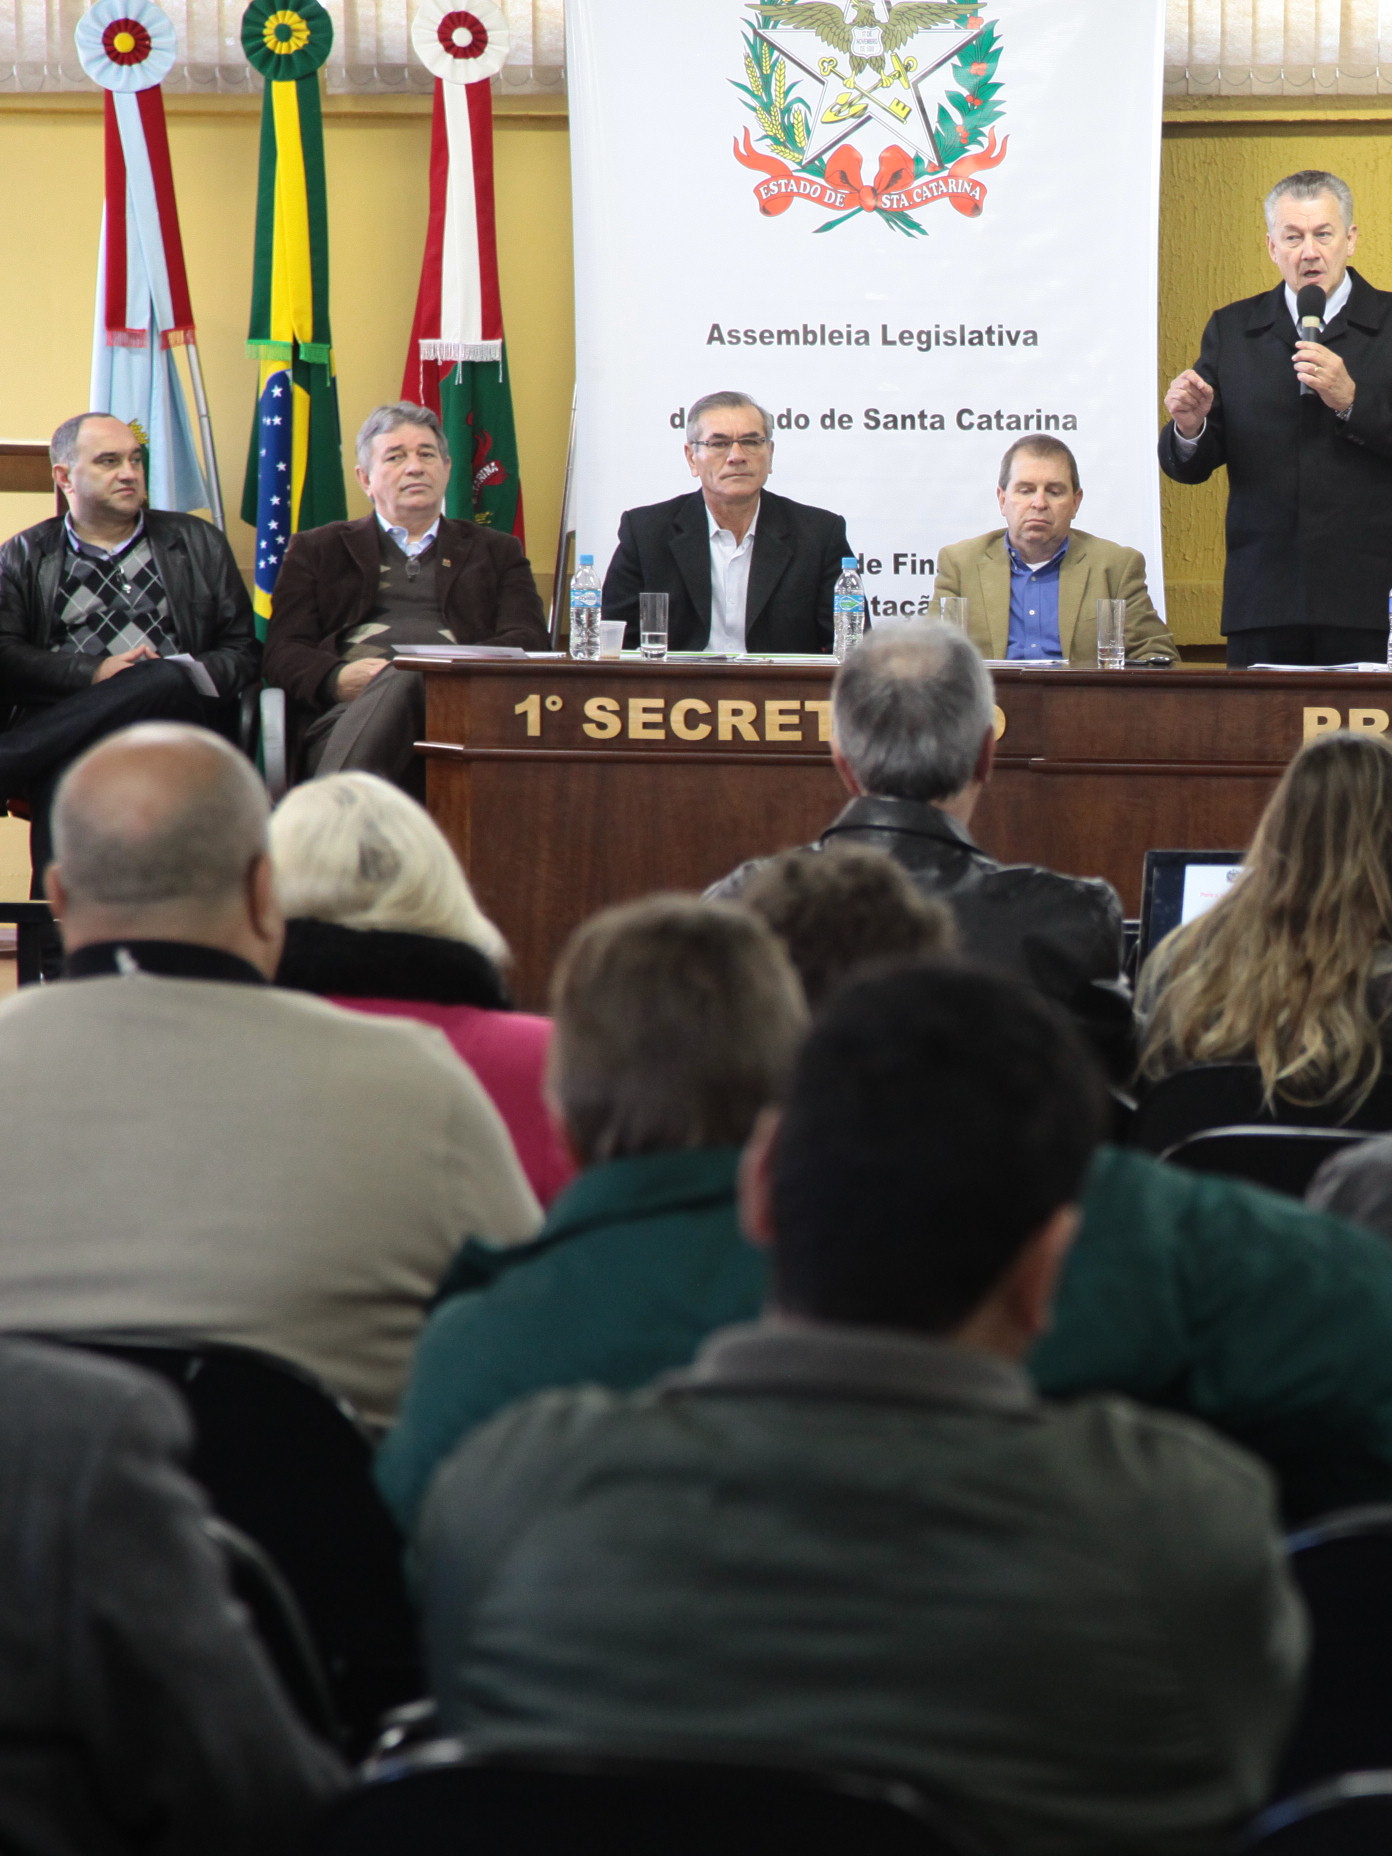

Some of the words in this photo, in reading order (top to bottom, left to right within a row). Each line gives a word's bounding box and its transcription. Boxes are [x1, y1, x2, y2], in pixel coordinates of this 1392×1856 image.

[759, 178, 821, 200] ESTADO
[823, 191, 845, 208] DE
[881, 193, 913, 209] STA.
[913, 175, 981, 204] CATARINA
[706, 323, 870, 346] Assembleia
[881, 324, 1039, 352] Legislativa
[819, 408, 854, 431] de
[863, 408, 945, 431] Santa
[956, 408, 1078, 431] Catarina
[582, 697, 1007, 742] SECRET
